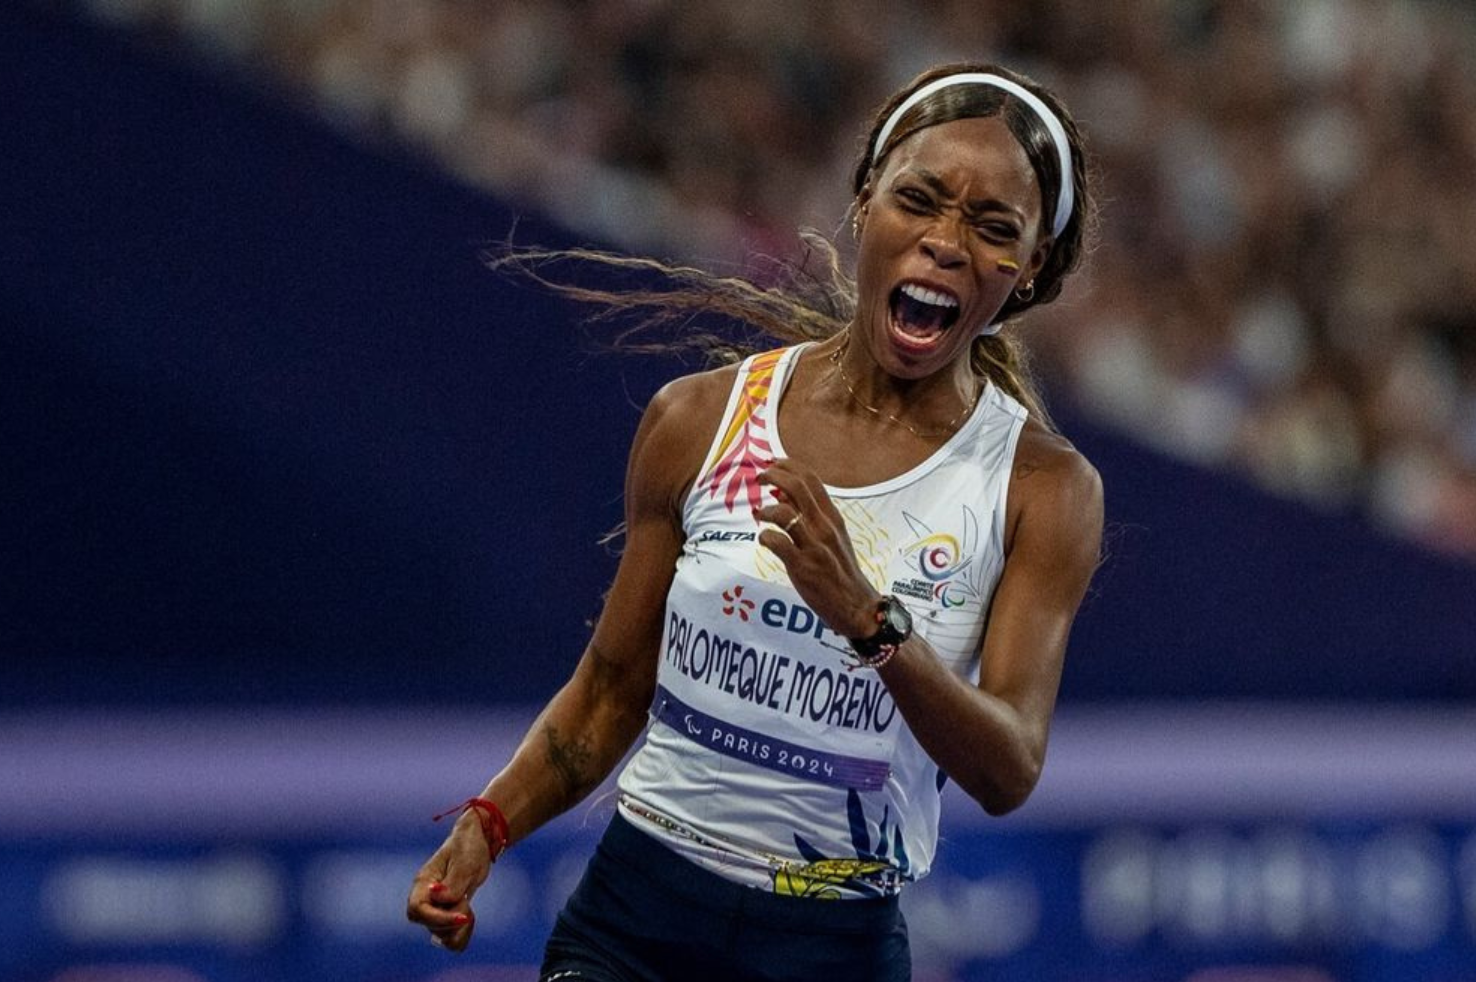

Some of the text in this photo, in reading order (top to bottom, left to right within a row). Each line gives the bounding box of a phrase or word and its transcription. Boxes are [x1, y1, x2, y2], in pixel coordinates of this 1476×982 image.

[699, 530, 756, 542] SAETA
[666, 611, 895, 733] PALOMEQUE MORENO
[711, 728, 833, 777] PARIS 2024
